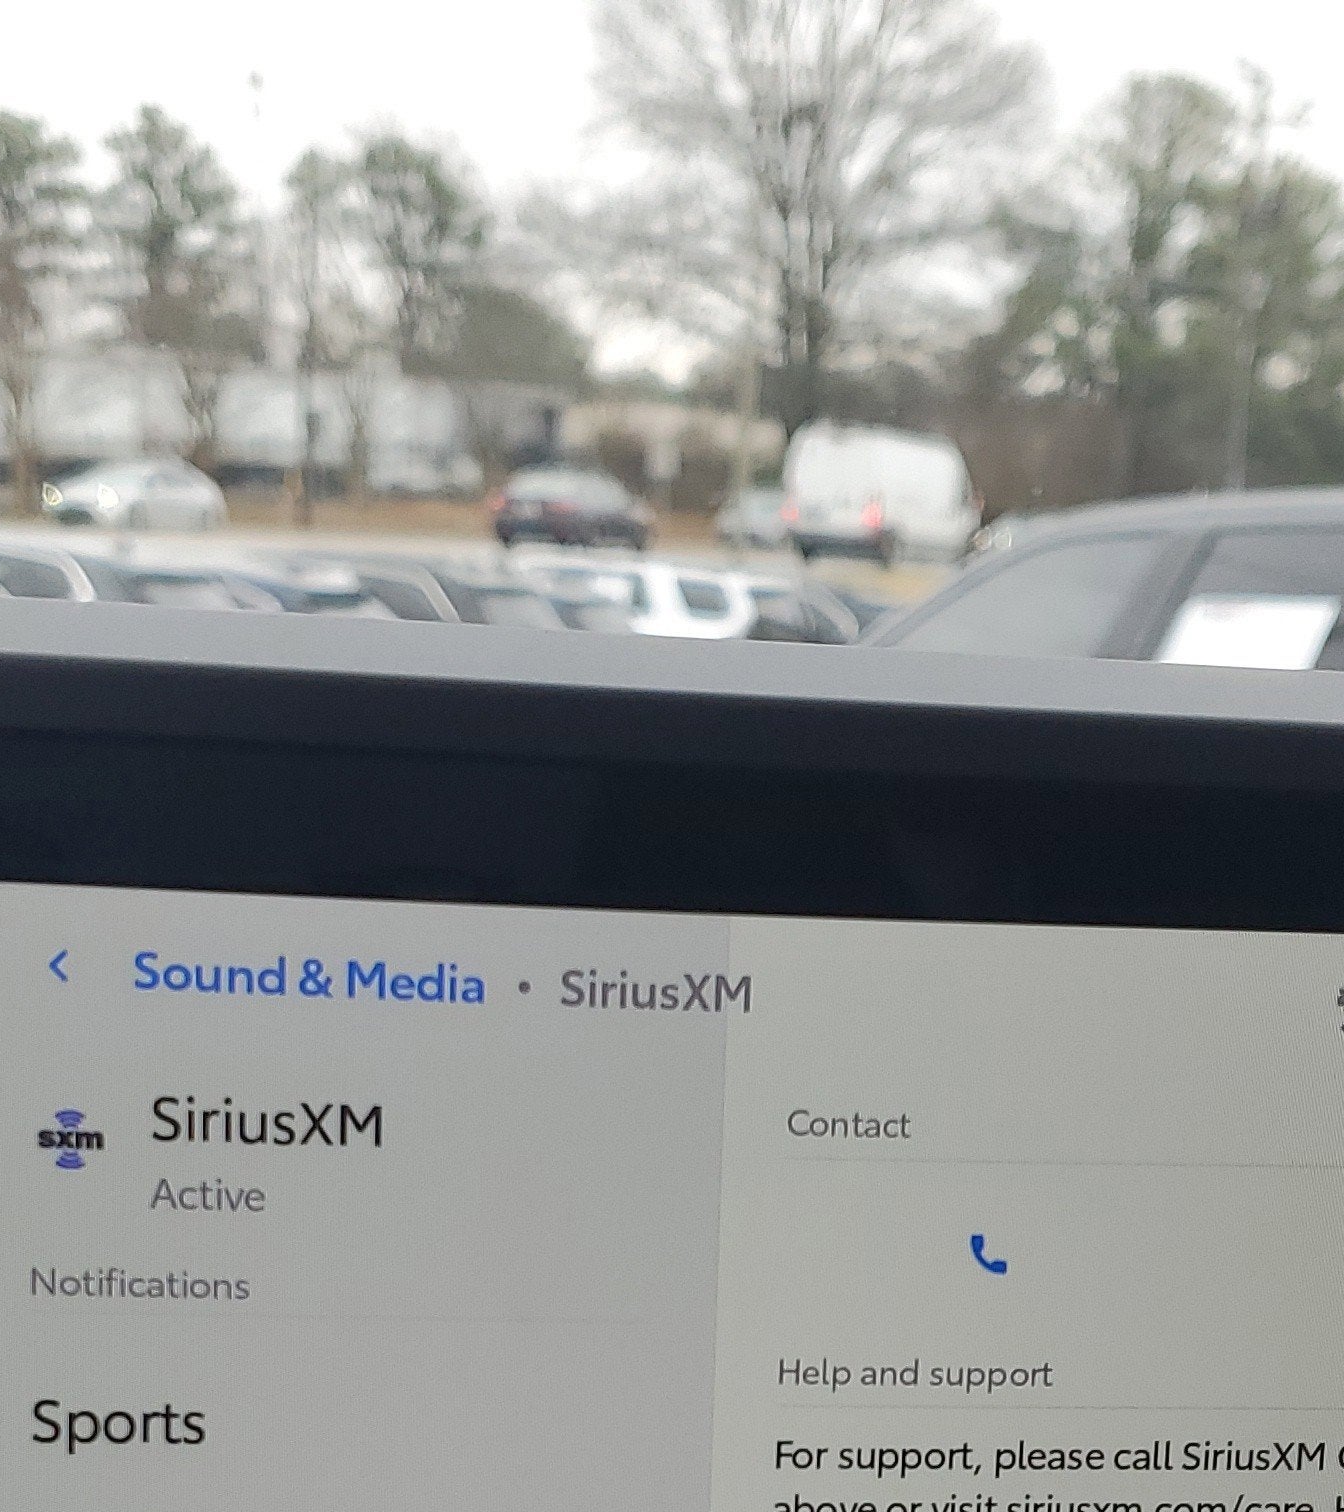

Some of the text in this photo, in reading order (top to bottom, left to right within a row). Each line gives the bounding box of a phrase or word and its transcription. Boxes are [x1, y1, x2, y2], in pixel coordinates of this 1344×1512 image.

[133, 951, 484, 1005] Sound & Media
[560, 970, 753, 1014] SiriusXM
[38, 1129, 105, 1150] sxm
[151, 1096, 383, 1148] SiriusXM
[787, 1109, 910, 1141] Contact
[151, 1178, 266, 1213] Active
[30, 1268, 250, 1301] Notifications
[778, 1359, 1053, 1394] Help and support
[32, 1400, 206, 1453] Sports
[775, 1440, 827, 1473] For
[838, 1443, 983, 1478] support,
[994, 1441, 1104, 1478] please
[1114, 1439, 1173, 1471] call
[1181, 1440, 1326, 1472] SiriusXM
